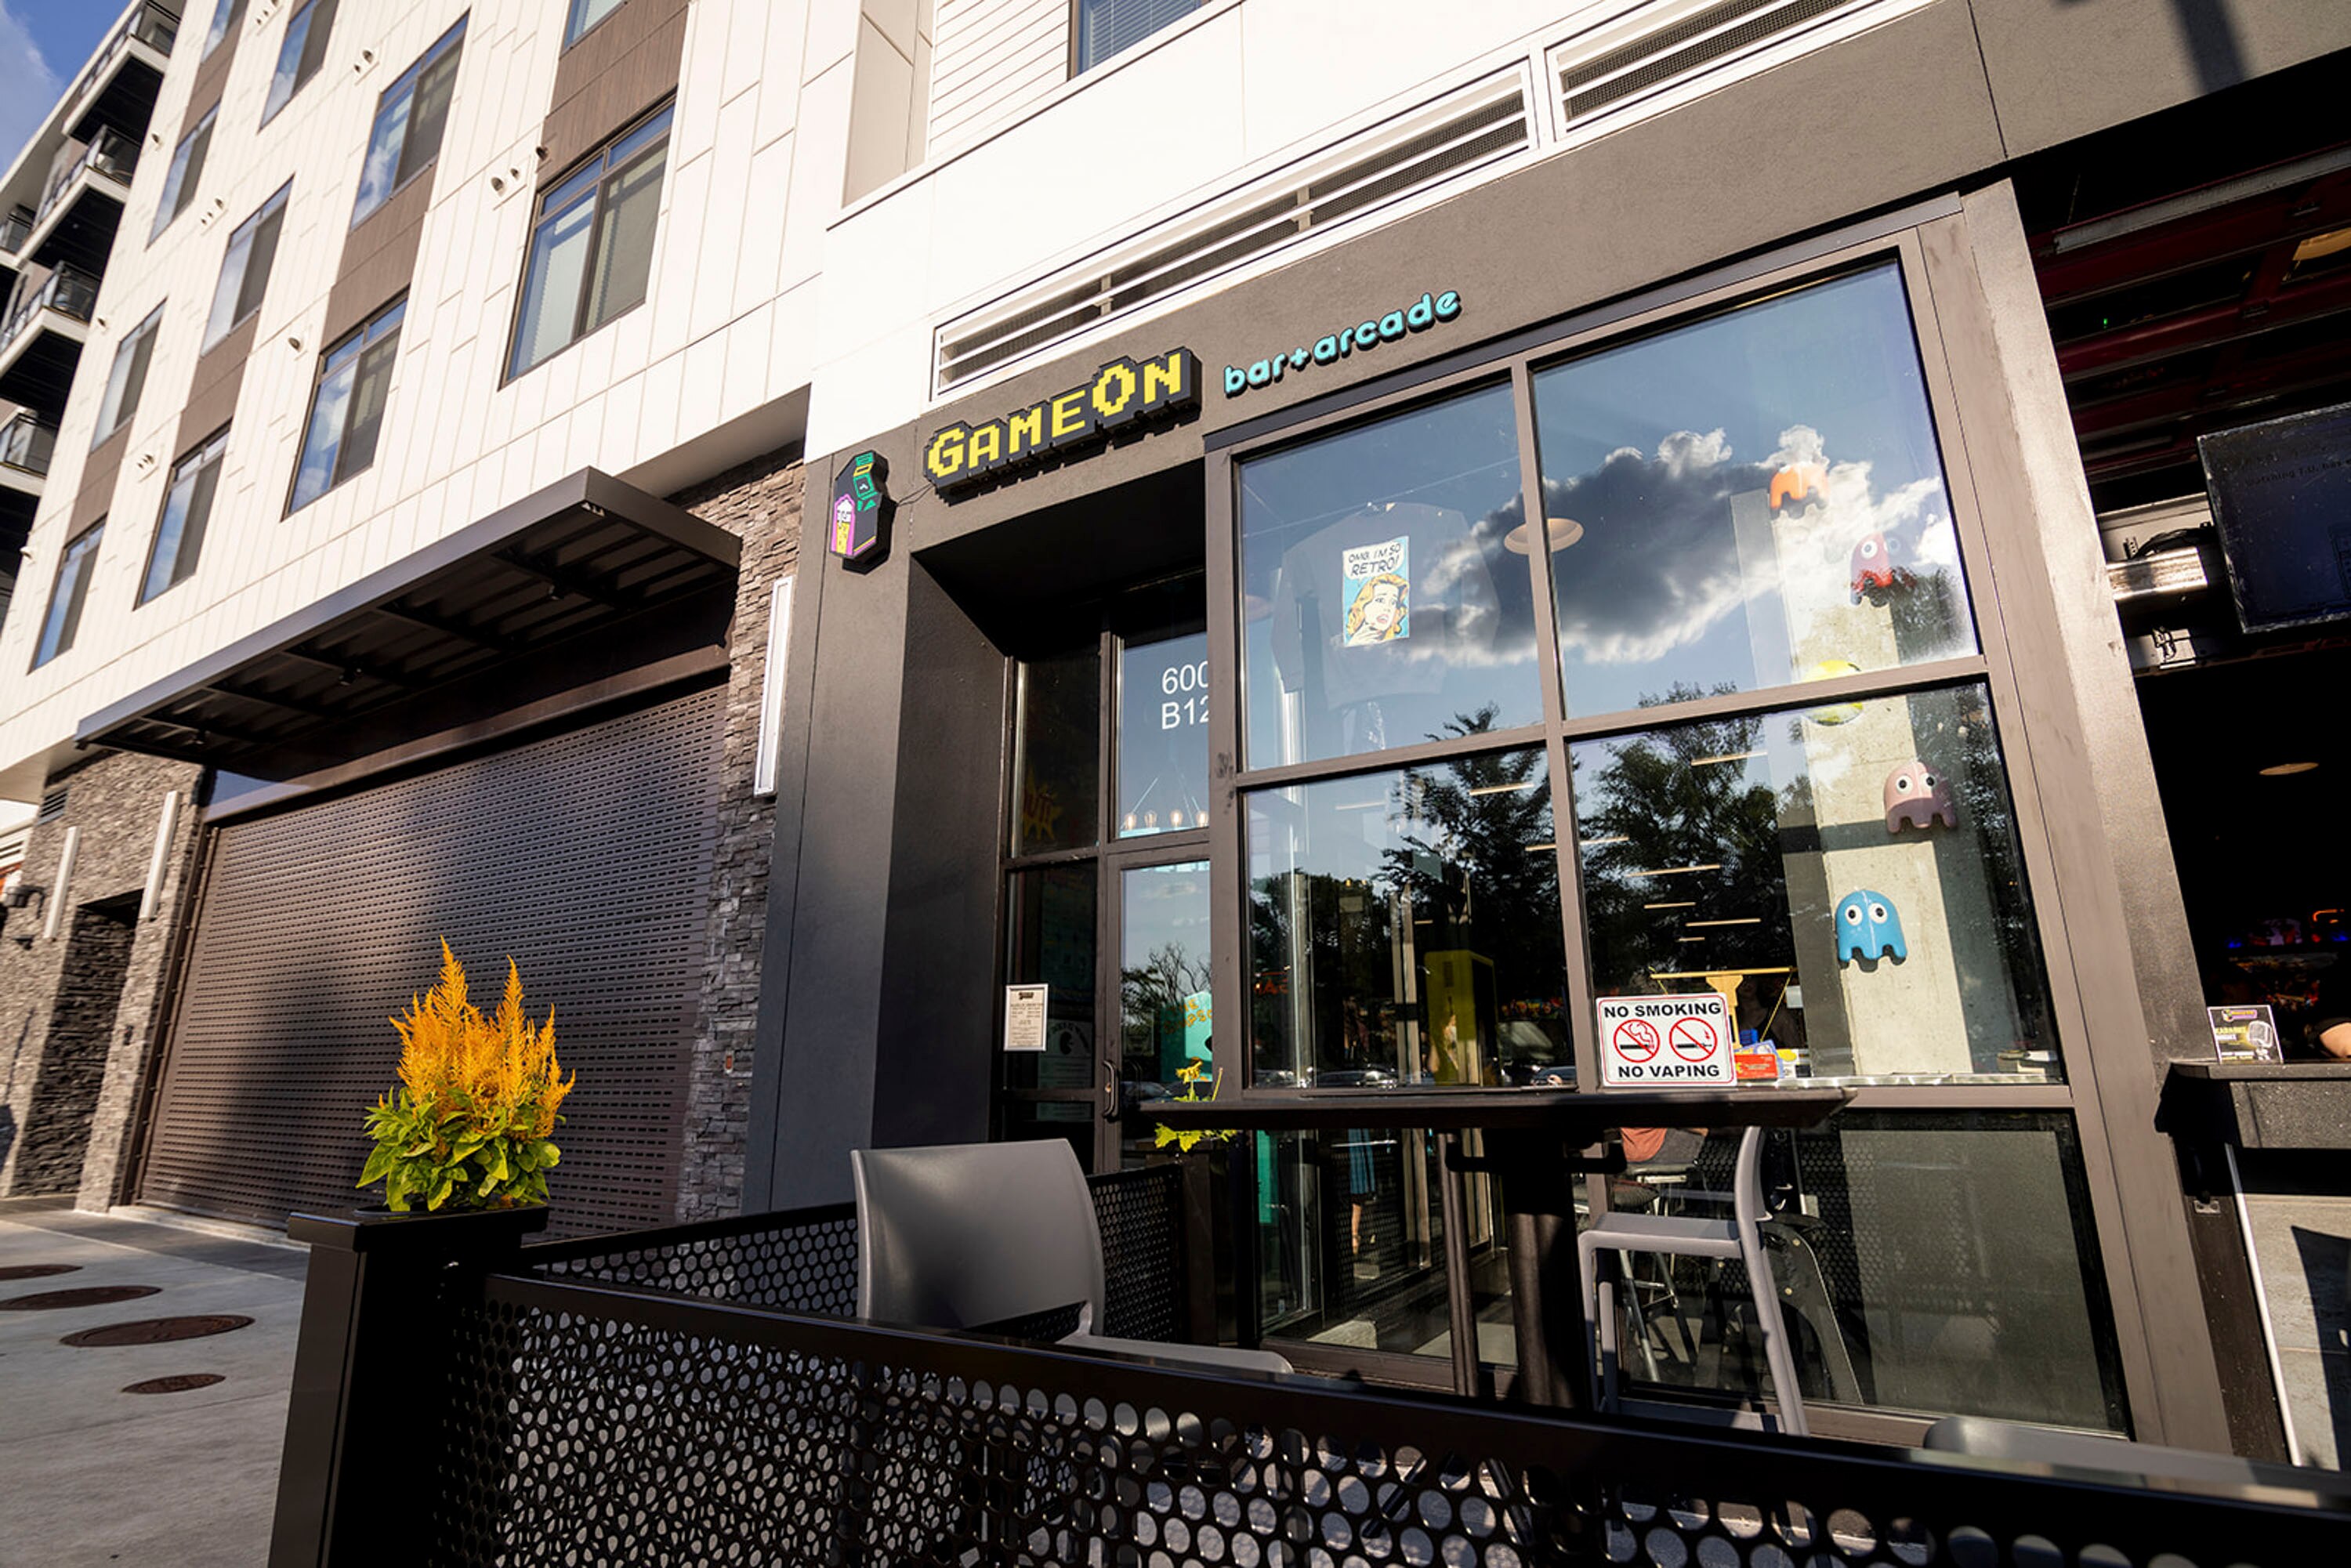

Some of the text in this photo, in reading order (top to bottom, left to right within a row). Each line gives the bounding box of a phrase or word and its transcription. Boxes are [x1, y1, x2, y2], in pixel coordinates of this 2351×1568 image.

[1223, 290, 1460, 394] bar+arcade
[1350, 555, 1400, 576] RETRO!
[1603, 1002, 1722, 1018] NO SMOKING
[1617, 1064, 1720, 1078] NO VAPING
